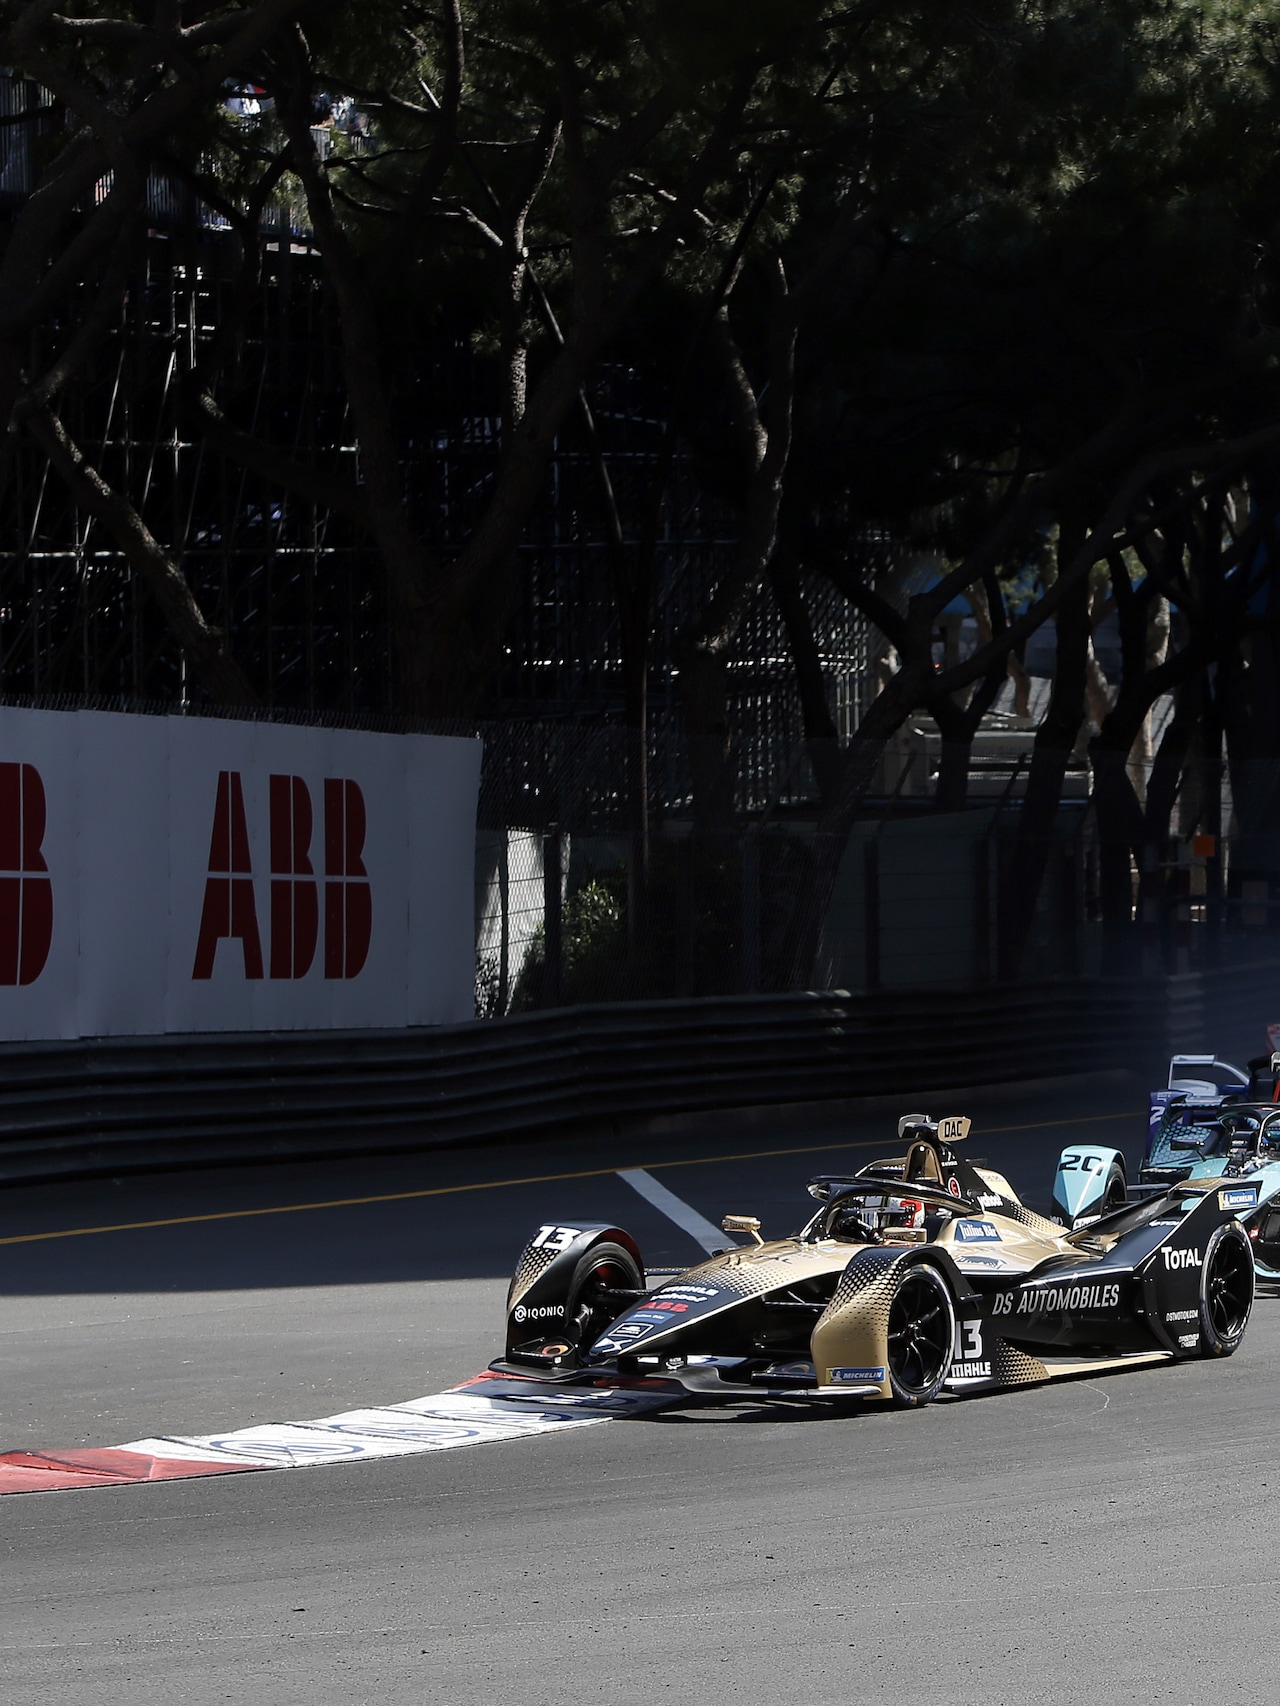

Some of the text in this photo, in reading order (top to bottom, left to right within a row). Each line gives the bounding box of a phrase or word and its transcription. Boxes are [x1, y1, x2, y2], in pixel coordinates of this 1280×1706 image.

[192, 770, 374, 980] ABB
[943, 1120, 964, 1138] DAC
[1058, 1153, 1104, 1177] 20
[532, 1225, 581, 1251] 13
[961, 1225, 984, 1239] Julius
[1161, 1246, 1203, 1270] TOTAL
[637, 1302, 690, 1313] ABB
[992, 1284, 1120, 1316] DS AUTOMOBILES
[527, 1304, 566, 1319] IQONIQ
[843, 1370, 883, 1380] MICHELIN
[950, 1361, 992, 1378] MAHLE
